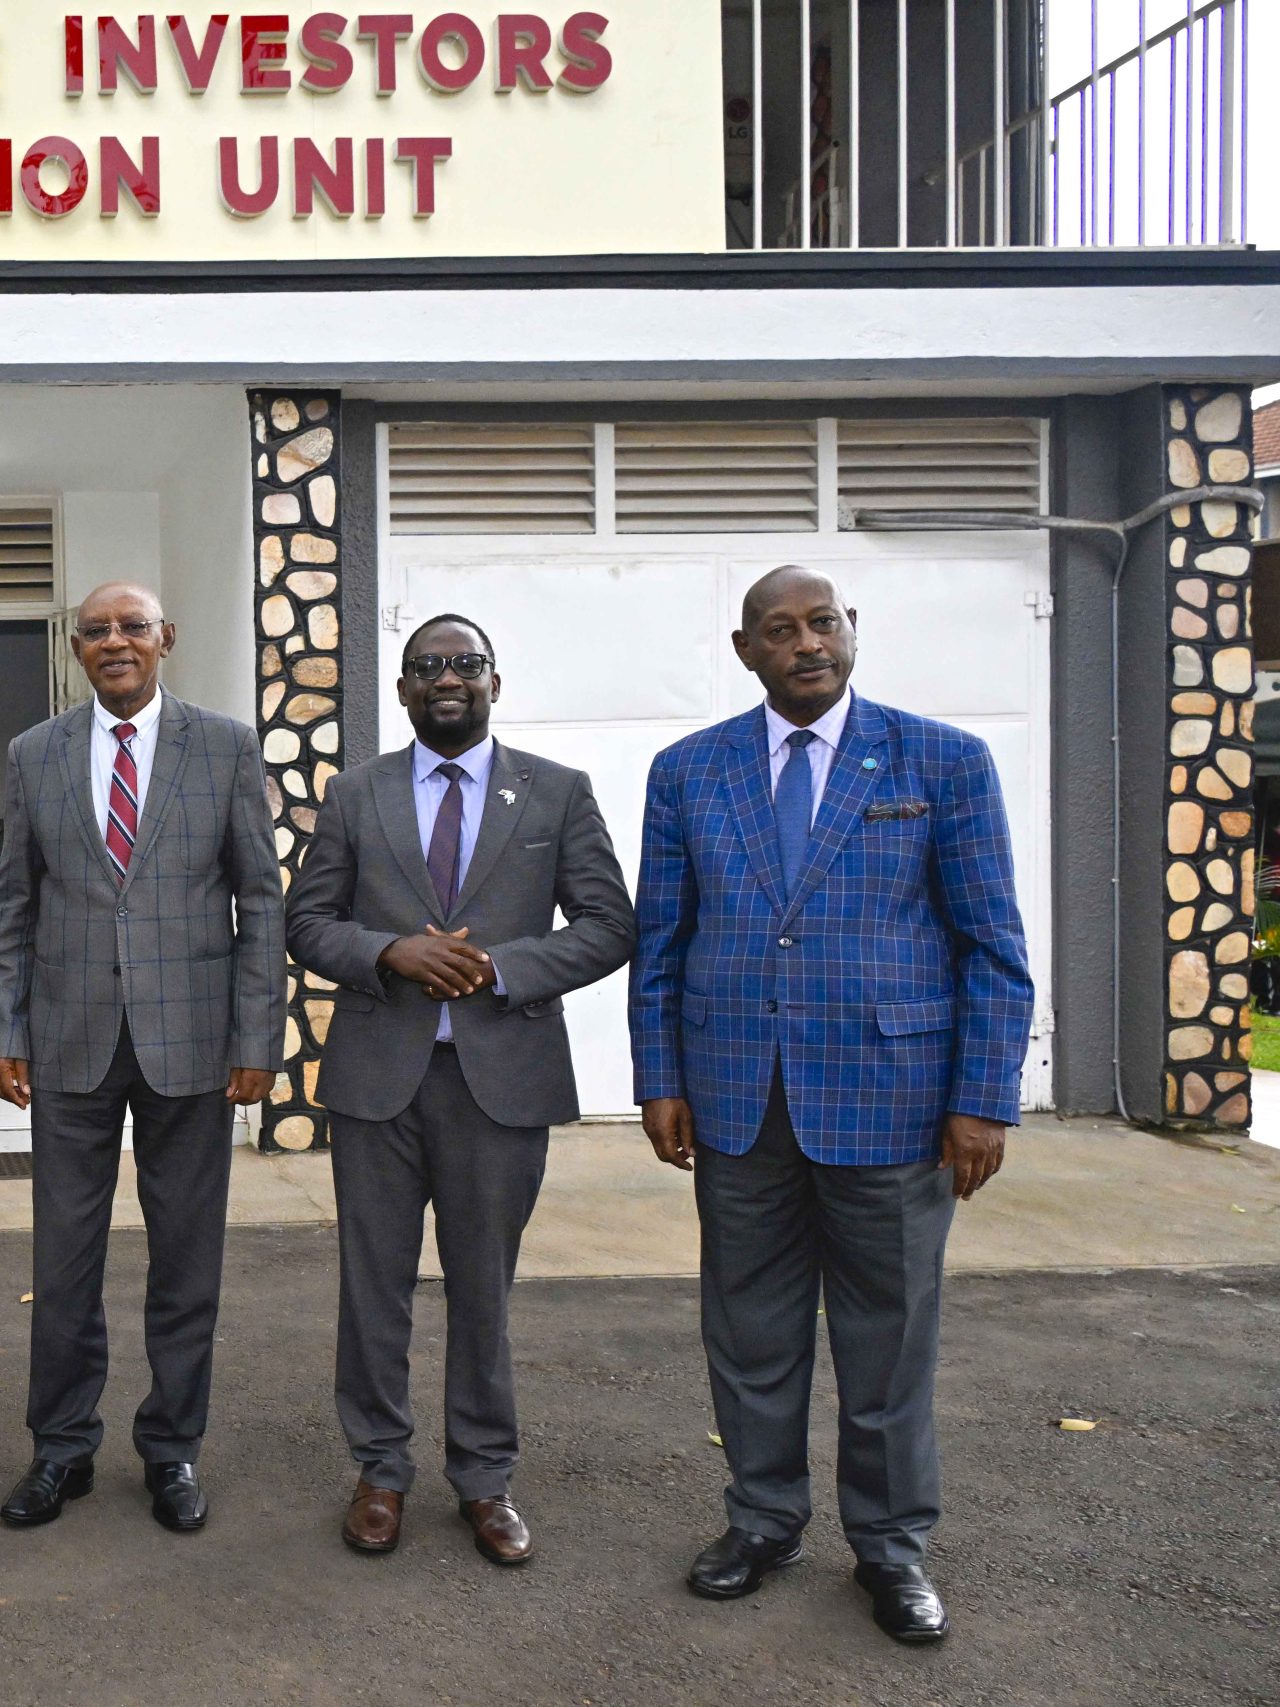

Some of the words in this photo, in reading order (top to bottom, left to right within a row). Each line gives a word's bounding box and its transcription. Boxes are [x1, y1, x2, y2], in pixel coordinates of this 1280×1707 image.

[65, 12, 613, 98] INVESTORS
[728, 126, 748, 139] LG
[219, 136, 453, 219] UNIT
